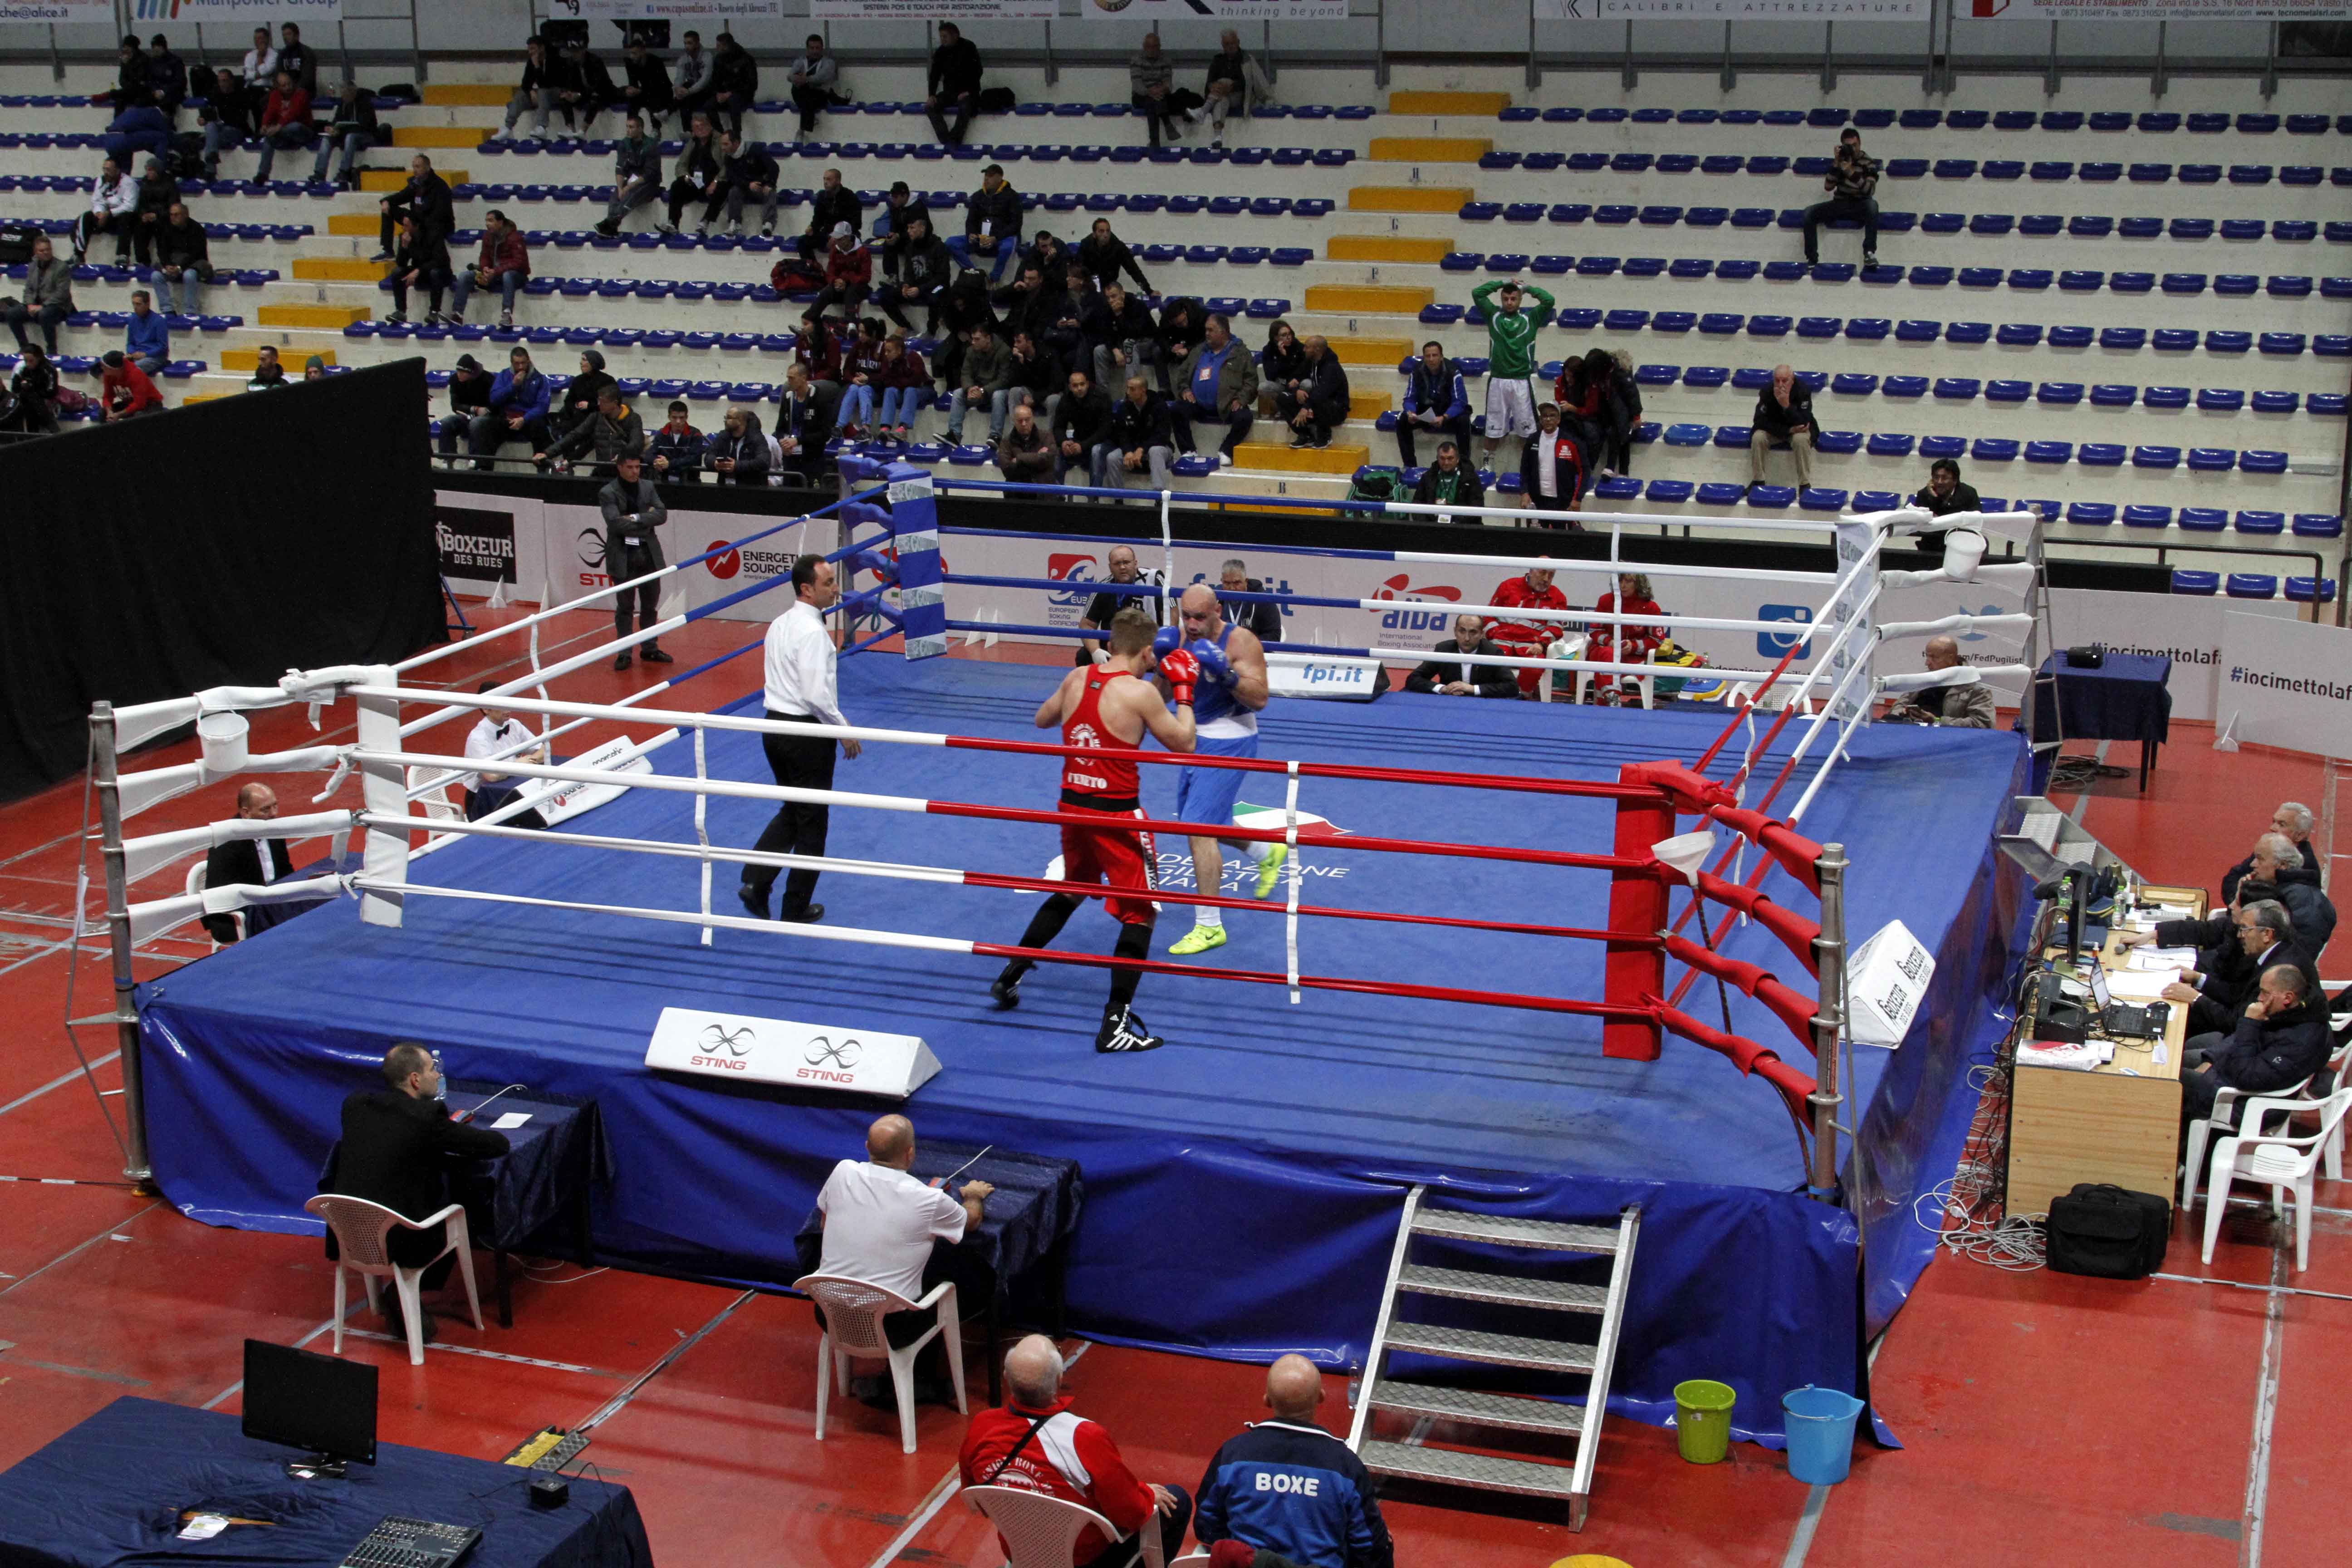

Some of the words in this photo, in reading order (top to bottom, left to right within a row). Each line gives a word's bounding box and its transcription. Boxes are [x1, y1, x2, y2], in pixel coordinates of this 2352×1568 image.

[1221, 7, 1279, 17] thinking
[1290, 6, 1344, 17] beyond
[1607, 3, 1694, 11] CALIBRI
[1715, 3, 1723, 11] E
[1744, 3, 1913, 12] ATTREZZATURE
[443, 533, 514, 558] BOXEUR
[454, 553, 473, 565] DES
[476, 555, 503, 568] RUES
[743, 551, 799, 564] ENERGET
[580, 573, 614, 587] STI
[1379, 632, 1423, 641] International
[1377, 640, 1401, 649] Boxing
[1403, 641, 1436, 649] Associati
[2092, 642, 2221, 665] iocimettolaf
[1303, 663, 1363, 684] fpi.it
[1903, 946, 1926, 980] BOXEUR
[1884, 983, 1908, 1020] BOXEUR
[690, 1055, 747, 1071] STING
[796, 1068, 855, 1083] STING
[1255, 1472, 1319, 1497] BOXE
